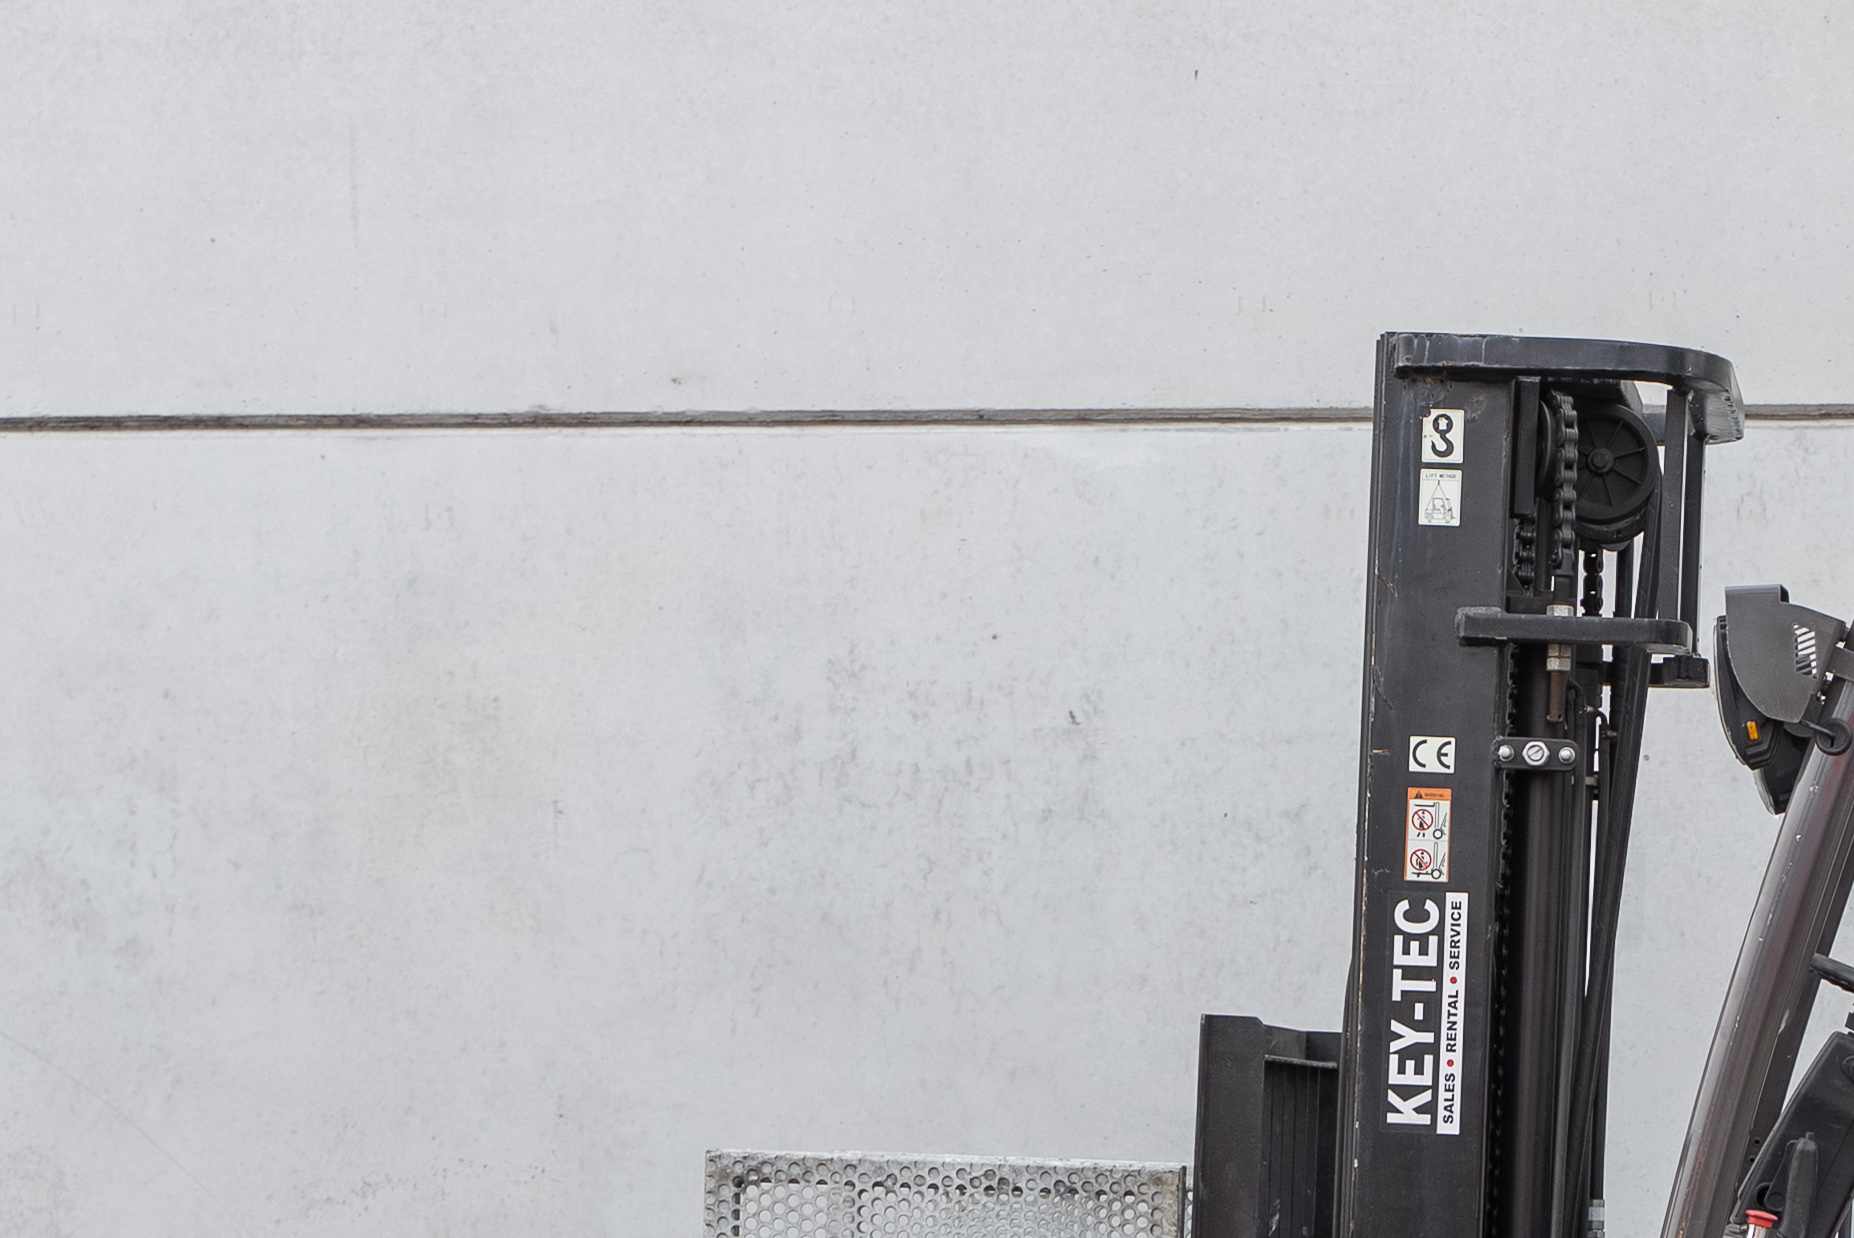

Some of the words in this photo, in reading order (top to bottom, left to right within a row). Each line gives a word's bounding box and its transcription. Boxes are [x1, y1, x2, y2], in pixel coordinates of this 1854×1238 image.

[1412, 739, 1451, 768] CE
[1449, 900, 1462, 971] SERVICE
[1386, 898, 1440, 1126] KEY-TEC
[1446, 989, 1459, 1054] RENTAL
[1442, 1073, 1456, 1125] SALES
